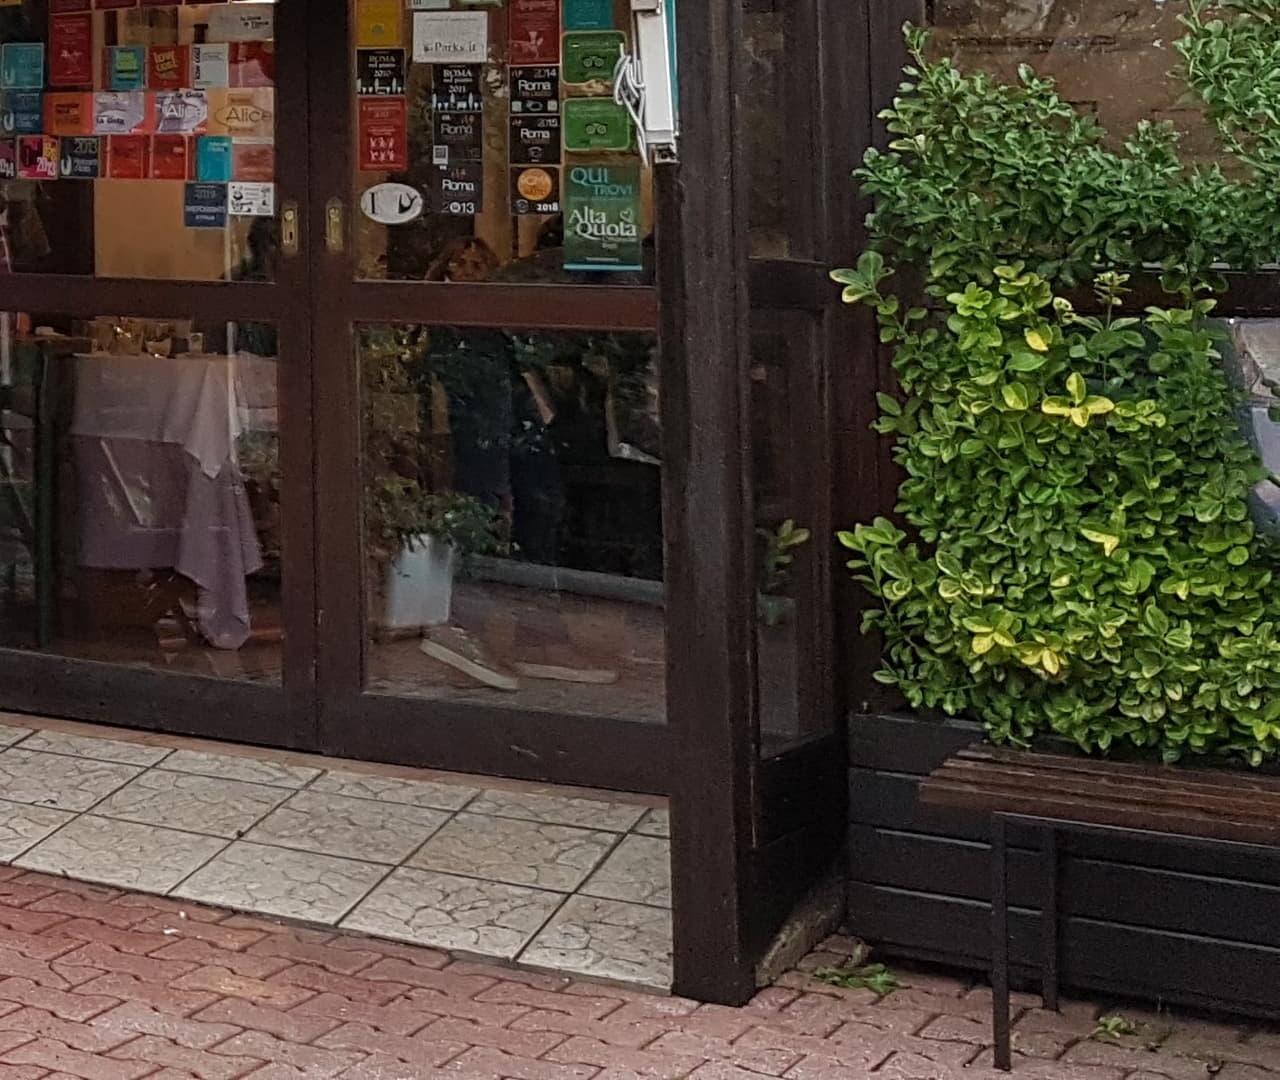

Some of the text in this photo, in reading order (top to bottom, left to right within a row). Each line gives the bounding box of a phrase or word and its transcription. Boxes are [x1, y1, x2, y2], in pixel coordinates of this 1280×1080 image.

[518, 79, 551, 91] Roma
[442, 179, 474, 191] Roma
[570, 167, 608, 186] QUI
[568, 205, 607, 224] Alta
[576, 221, 637, 241] Quota
